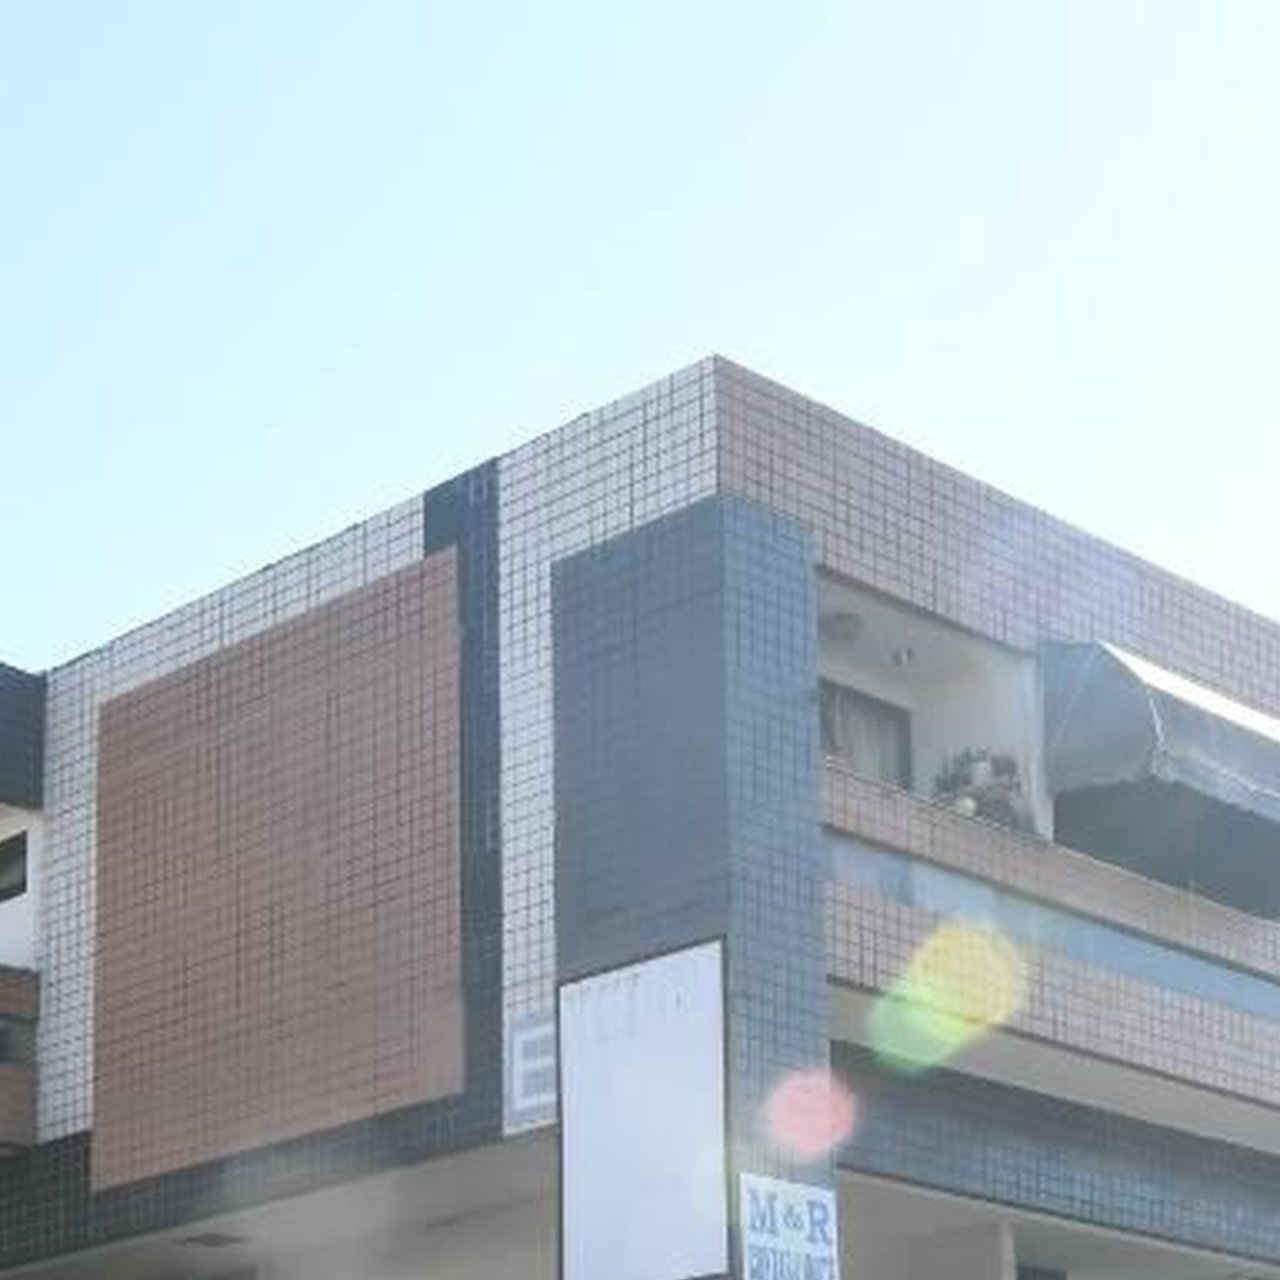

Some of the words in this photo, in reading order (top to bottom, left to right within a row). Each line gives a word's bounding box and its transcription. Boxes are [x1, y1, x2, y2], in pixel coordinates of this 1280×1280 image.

[747, 1189, 779, 1236] M
[783, 1202, 805, 1231] &
[806, 1199, 833, 1245] R
